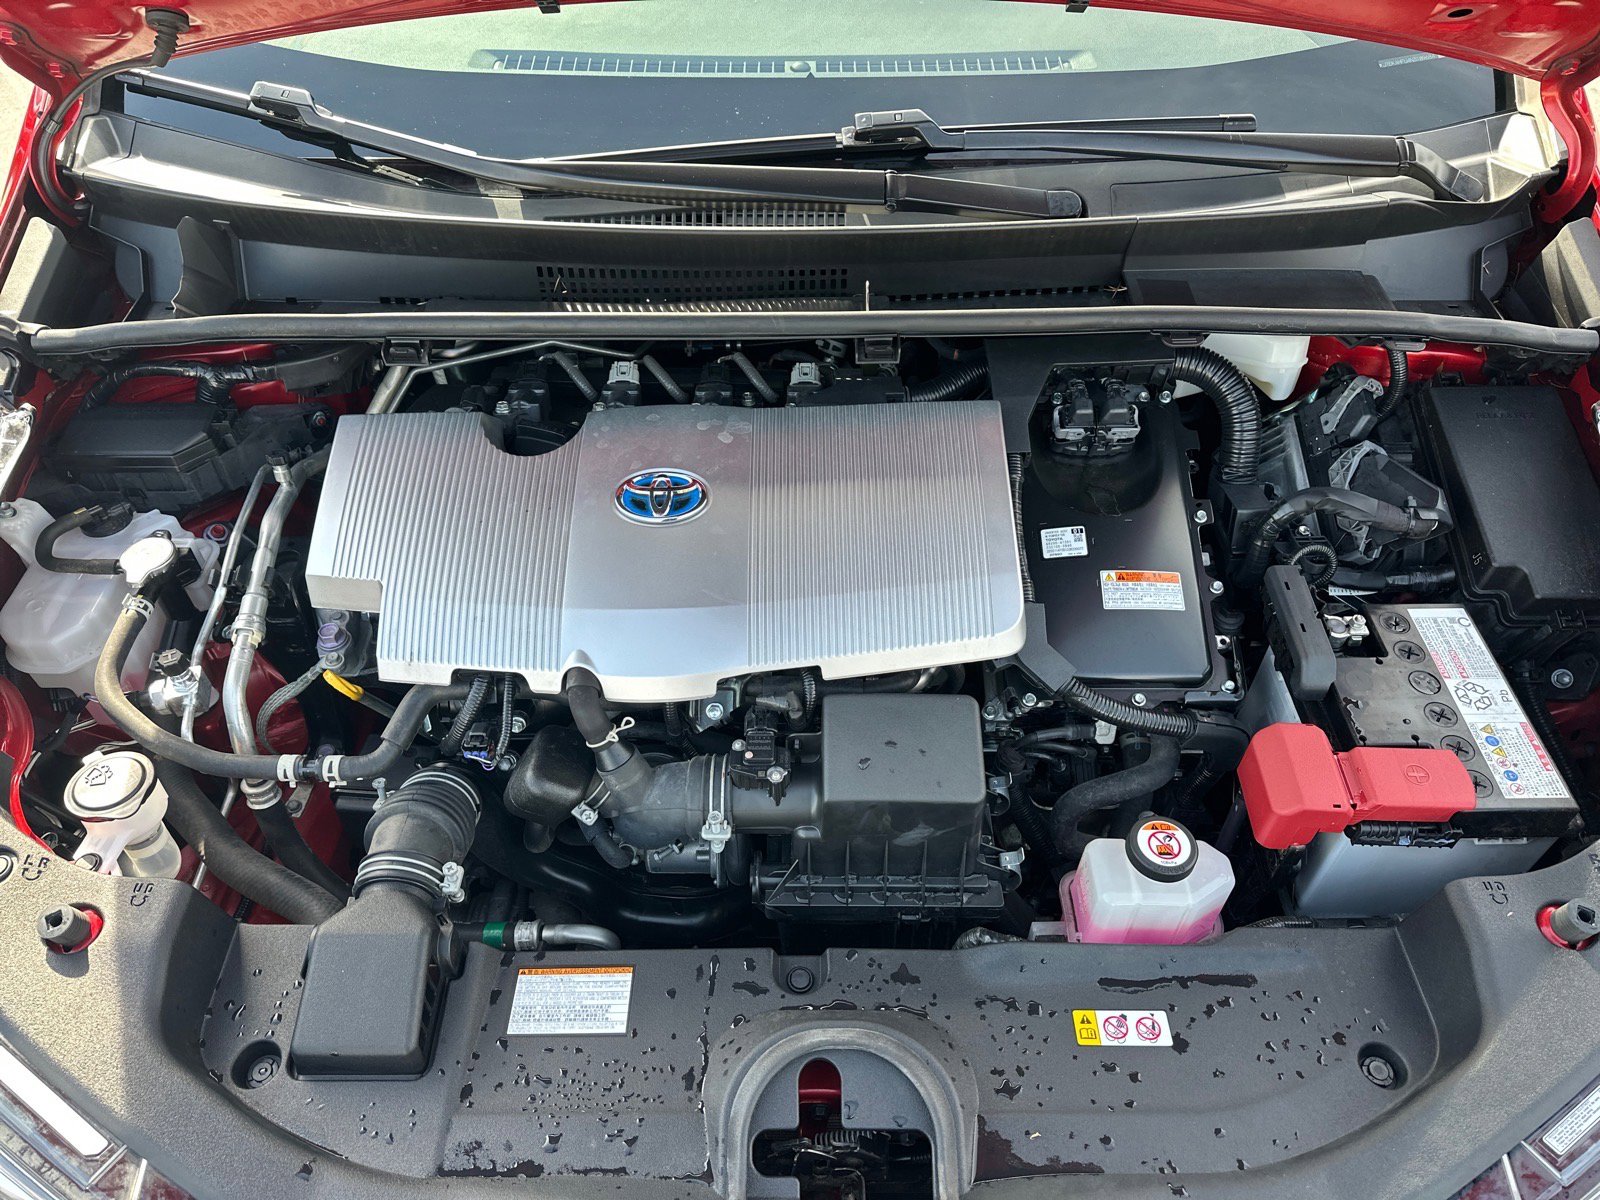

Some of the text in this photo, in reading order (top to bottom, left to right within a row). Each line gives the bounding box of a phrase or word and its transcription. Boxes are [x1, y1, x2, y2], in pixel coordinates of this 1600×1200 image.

[1472, 552, 1482, 566] J5
[1448, 650, 1465, 672] POISON
[1499, 689, 1513, 702] Pb
